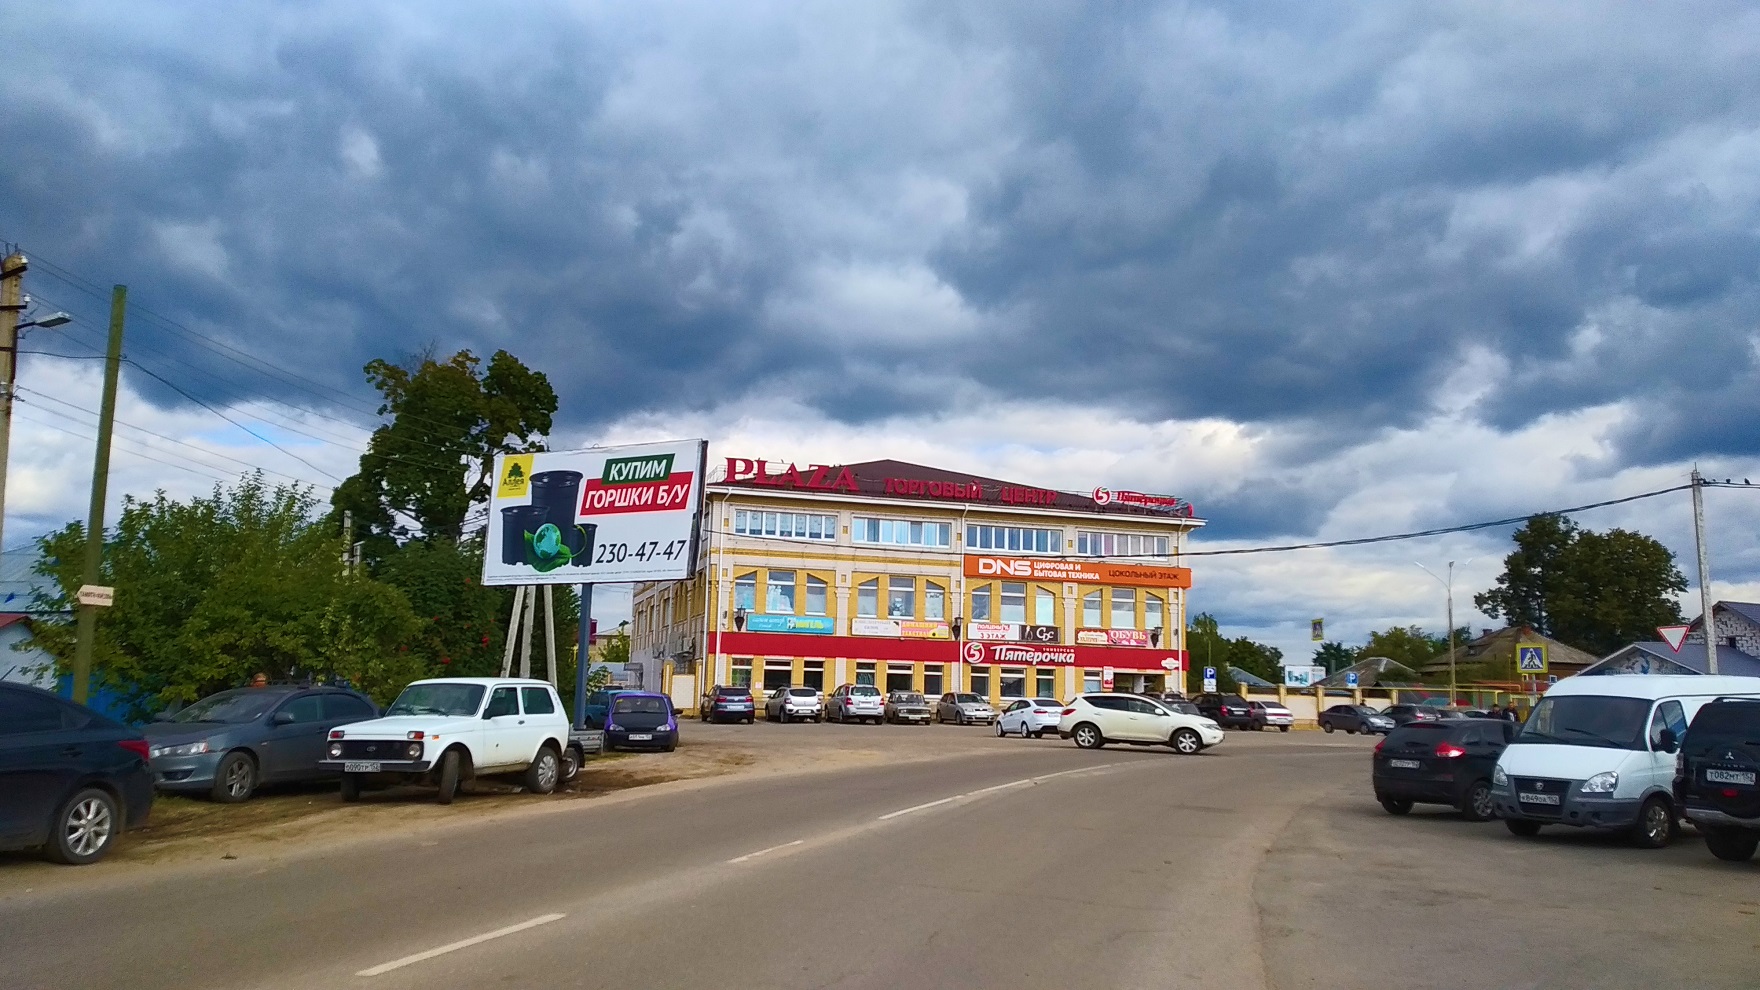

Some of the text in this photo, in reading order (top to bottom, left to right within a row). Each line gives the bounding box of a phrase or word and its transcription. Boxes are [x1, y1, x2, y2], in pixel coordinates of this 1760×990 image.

[608, 459, 666, 481] КУПИМ
[722, 457, 860, 492] PLAZA
[585, 484, 690, 509] ГОРШКИ Б/У
[884, 478, 1057, 505] ТОРГОВЫЙ ЦЕНТР
[595, 540, 688, 564] 230-47-47
[978, 558, 1032, 576] DNS
[1033, 562, 1081, 571] ЦИФРОВАЯ И
[1033, 570, 1100, 580] БЫТОВАЯ ТЕХНИКА
[1108, 569, 1180, 580] ЦОКОЛЬНЫЙ ЭТАЖ
[1110, 630, 1147, 640] ОБУВЬ
[990, 645, 1076, 665] Пятерочка
